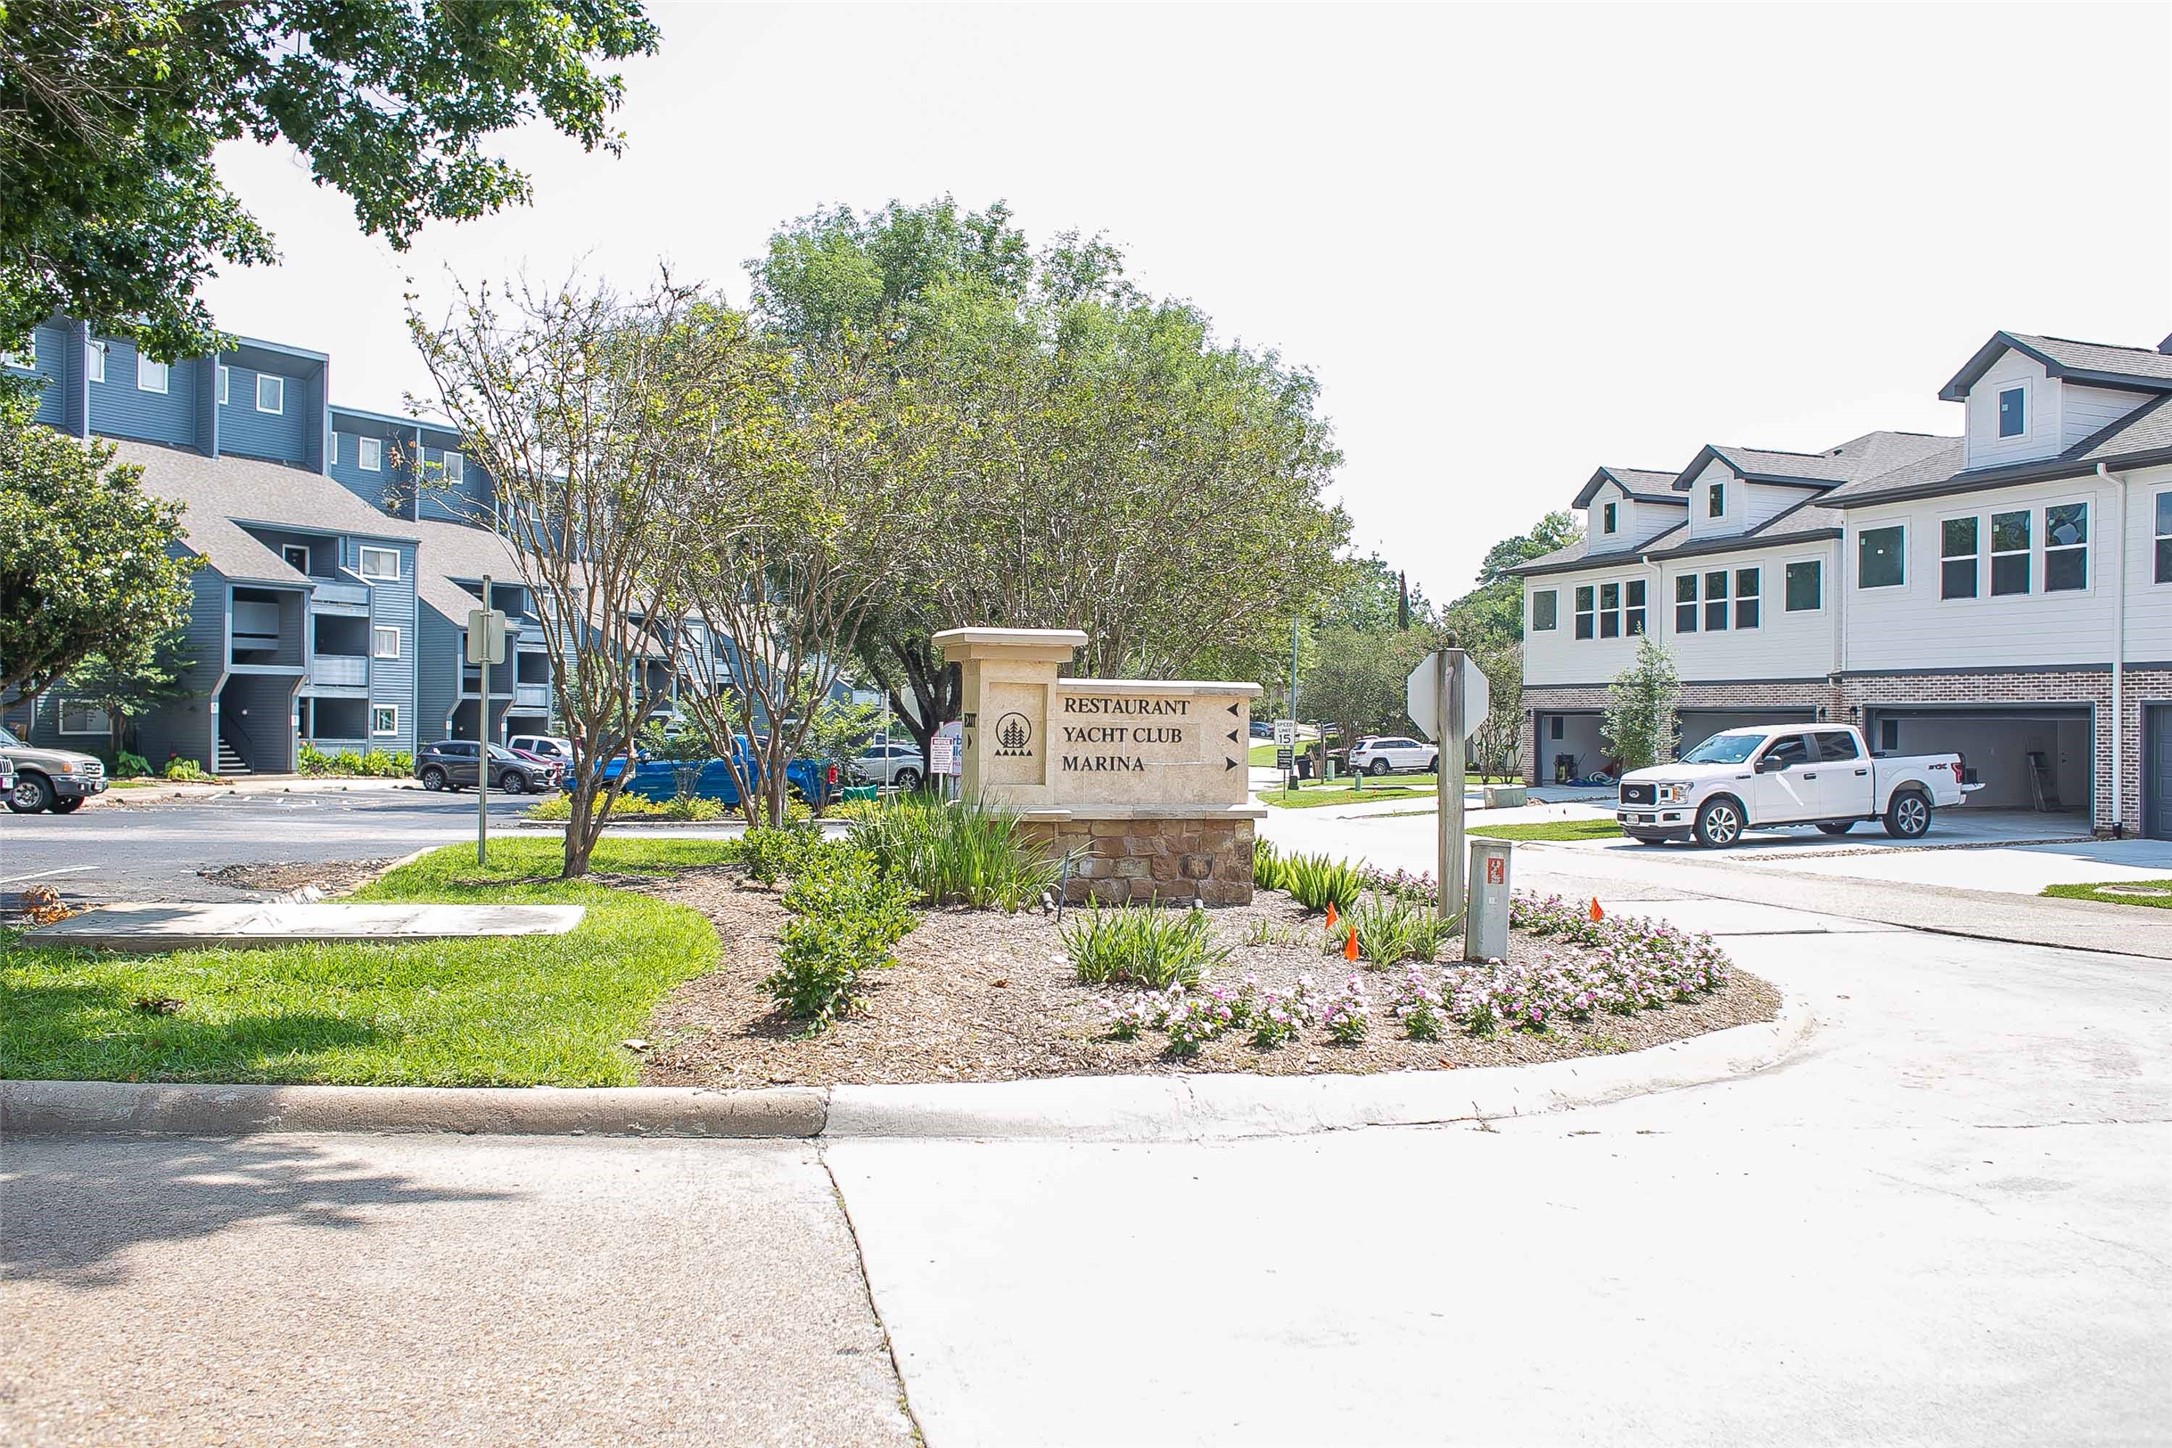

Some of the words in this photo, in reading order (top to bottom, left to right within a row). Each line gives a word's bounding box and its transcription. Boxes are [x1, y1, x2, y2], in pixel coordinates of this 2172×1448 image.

[1063, 697, 1191, 715] RESTAURANT
[964, 713, 977, 728] EXIT
[1063, 726, 1129, 743] YACHT
[1132, 727, 1182, 743] CLUB
[1278, 734, 1291, 744] 15
[1062, 755, 1145, 772] MARINA
